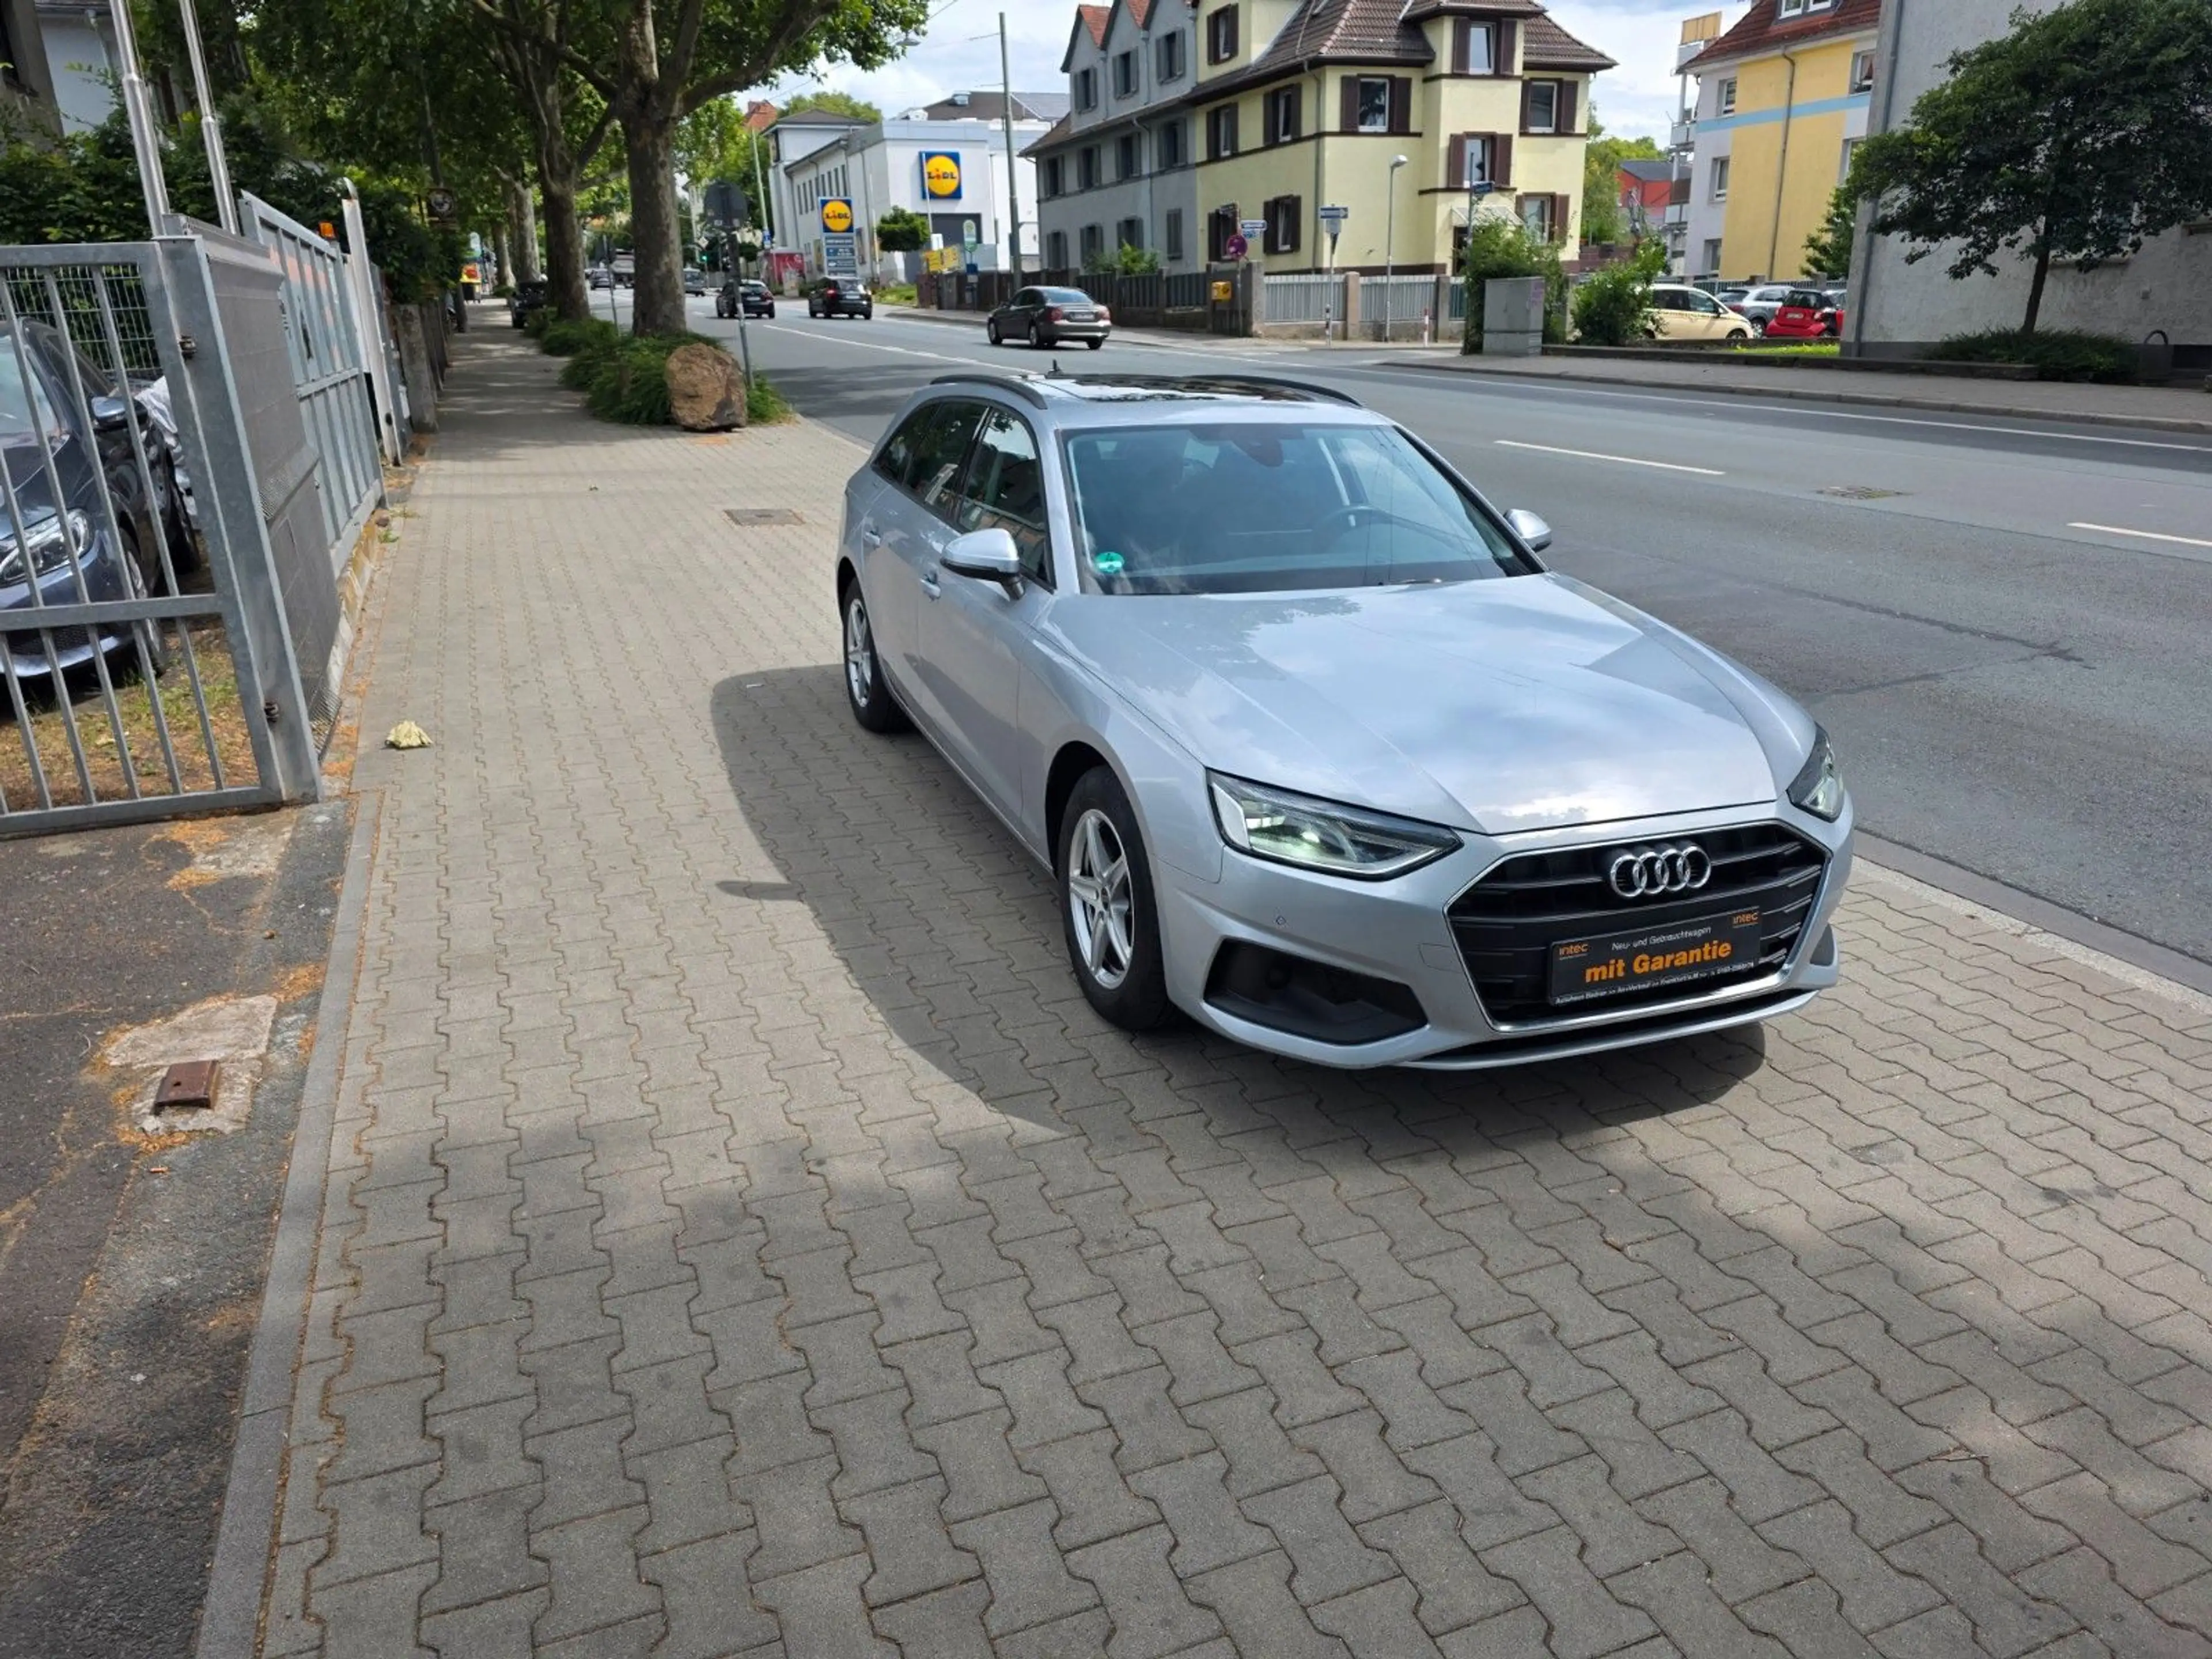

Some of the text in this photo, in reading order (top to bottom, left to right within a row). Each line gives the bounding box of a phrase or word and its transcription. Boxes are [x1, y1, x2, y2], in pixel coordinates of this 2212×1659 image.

[1633, 938, 1648, 948] und
[1649, 926, 1711, 945] Gebrauchtwagen
[1559, 943, 1588, 956] intec
[1585, 959, 1626, 983] mit
[1633, 939, 1733, 975] Garantie
